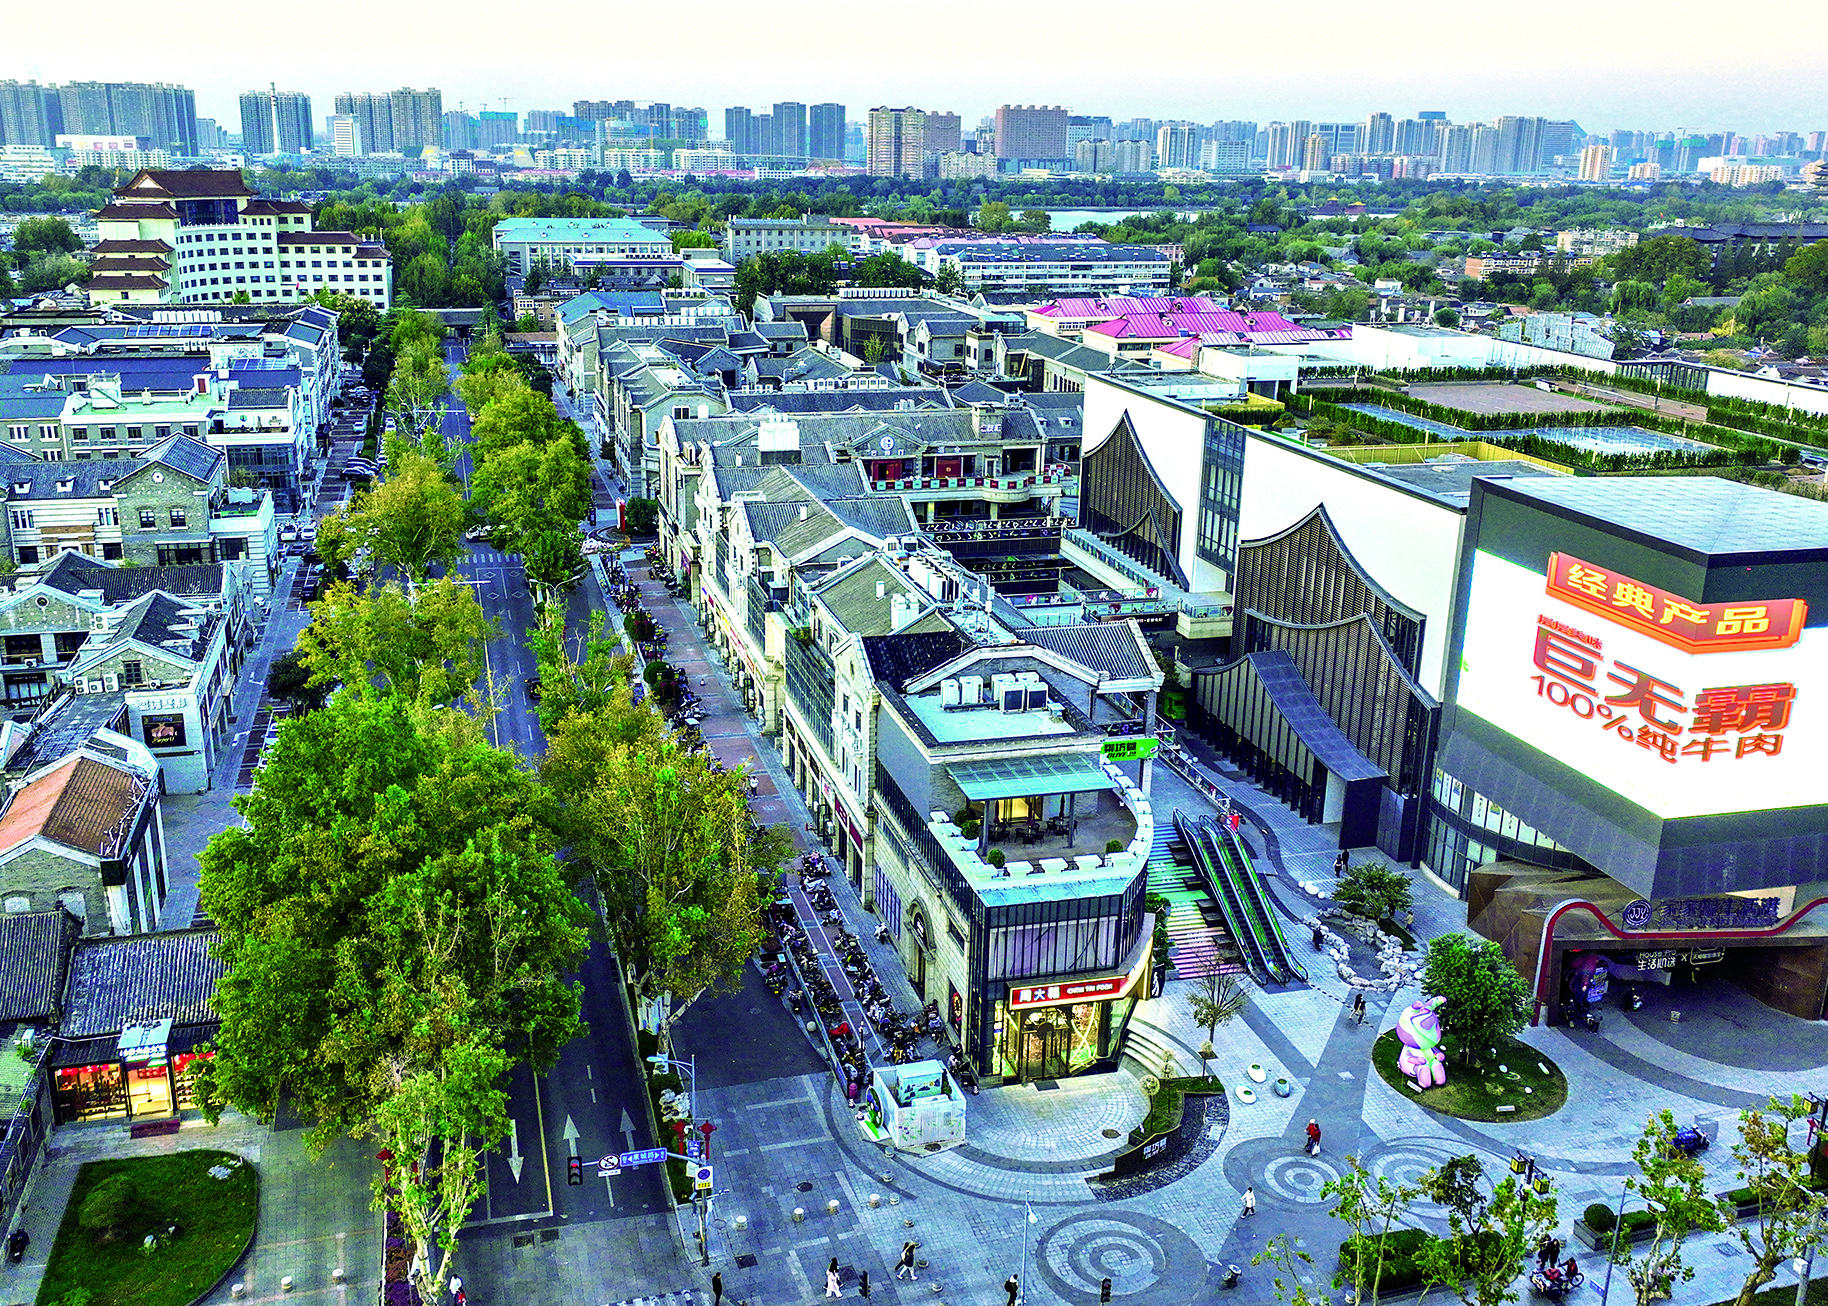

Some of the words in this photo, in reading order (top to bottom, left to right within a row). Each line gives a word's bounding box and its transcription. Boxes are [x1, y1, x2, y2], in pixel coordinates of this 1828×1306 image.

[1567, 563, 1770, 635] 经典产品
[1530, 675, 1784, 764] 100%纯牛肉
[1534, 626, 1799, 735] 巨无霸
[1630, 906, 1647, 920] JJY
